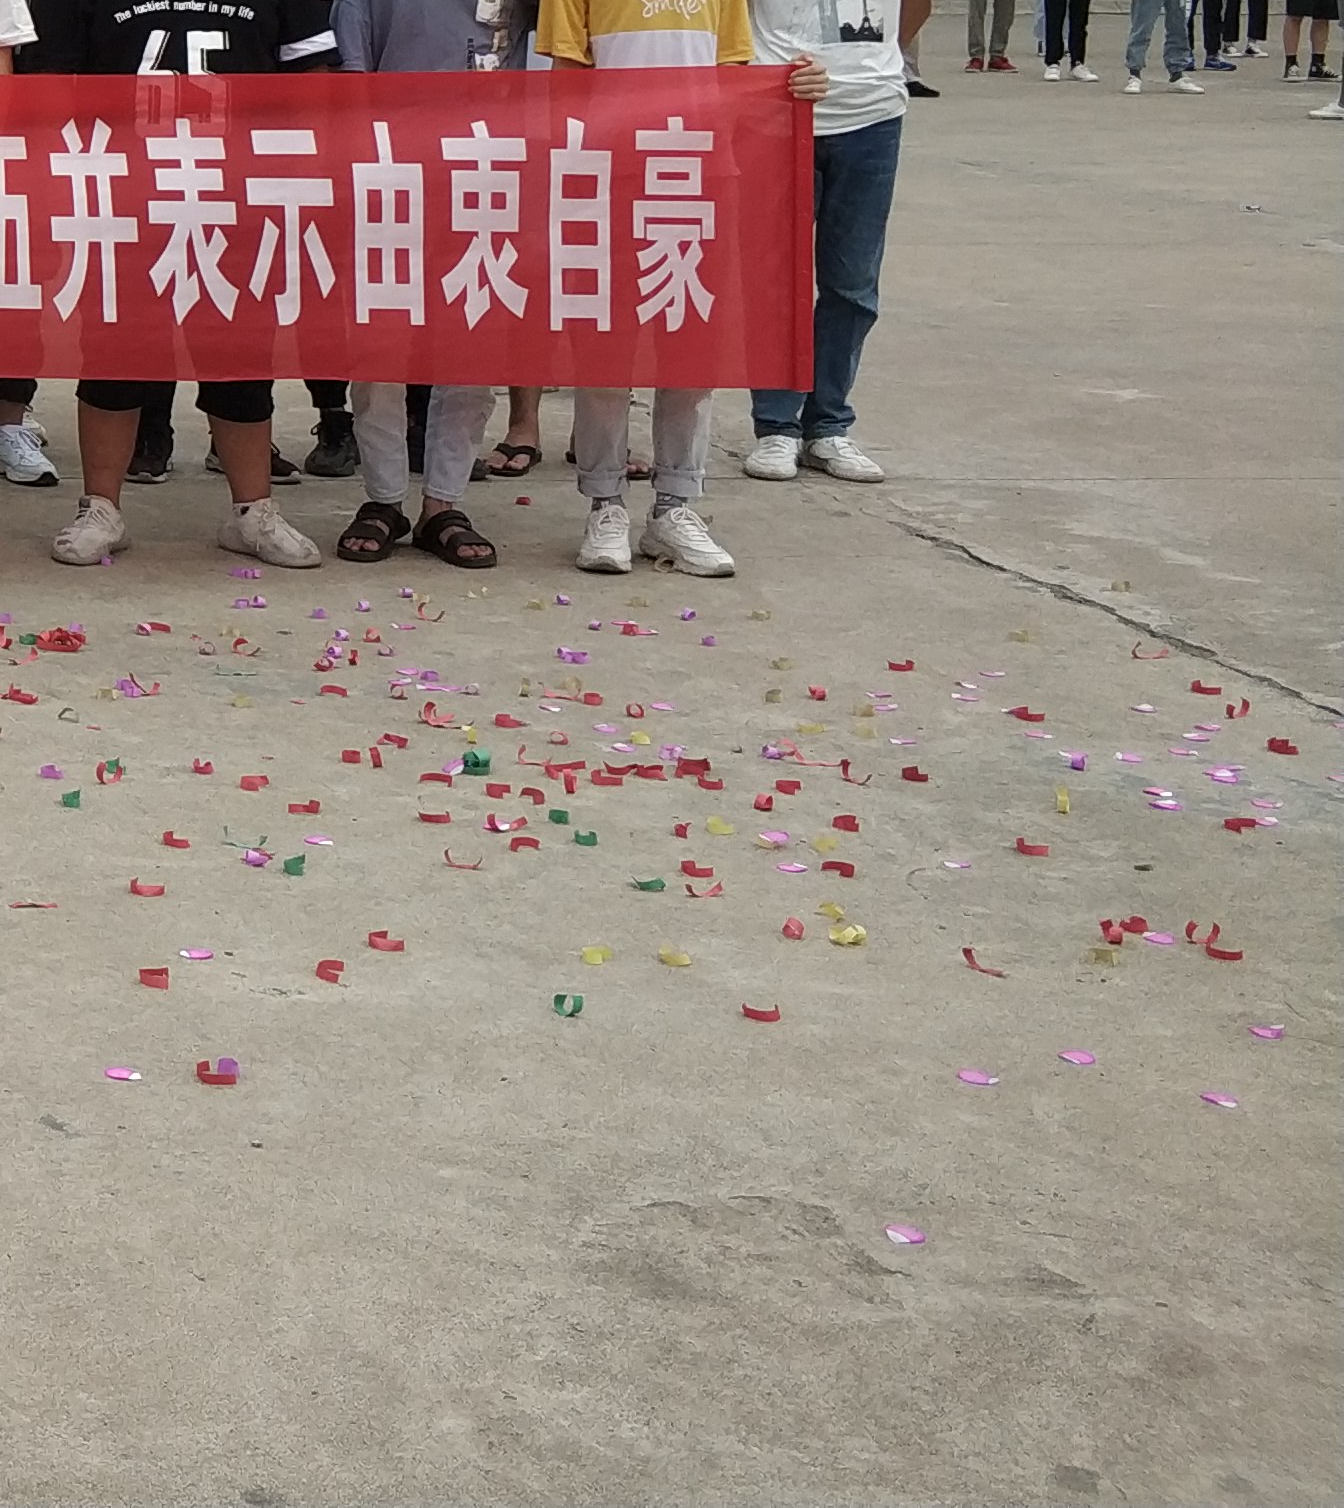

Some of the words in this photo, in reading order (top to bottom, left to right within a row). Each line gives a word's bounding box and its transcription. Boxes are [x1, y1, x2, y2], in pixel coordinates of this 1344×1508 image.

[113, 9, 132, 24] The
[173, 0, 206, 12] number
[208, 0, 218, 13] in
[221, 4, 236, 18] my
[238, 6, 255, 21] life
